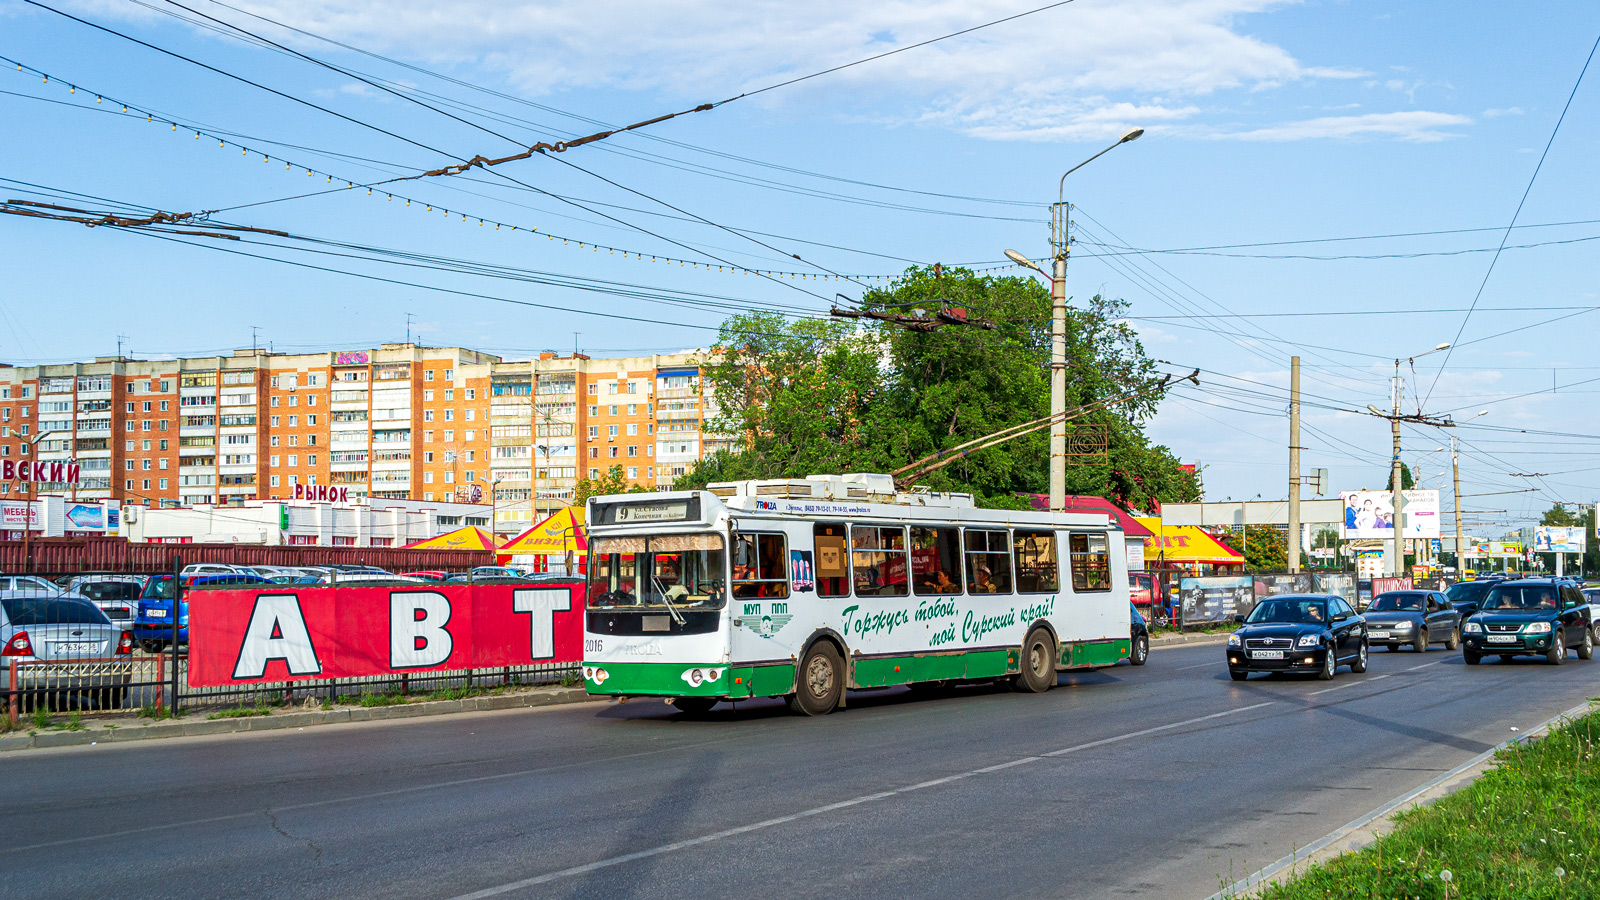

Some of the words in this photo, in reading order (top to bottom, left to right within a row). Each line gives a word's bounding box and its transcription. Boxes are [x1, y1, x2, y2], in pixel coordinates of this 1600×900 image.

[295, 483, 348, 502] РЫНОК
[620, 507, 629, 520] 9
[524, 537, 572, 545] ВИЗИТ
[744, 603, 761, 615] МУП
[771, 603, 788, 614] ППП
[842, 604, 909, 640] Горжусь
[914, 597, 959, 622] тобой,
[928, 622, 956, 647] мой
[962, 608, 1015, 643] Сурский
[1020, 595, 1056, 627] край!
[585, 639, 603, 652] 2016
